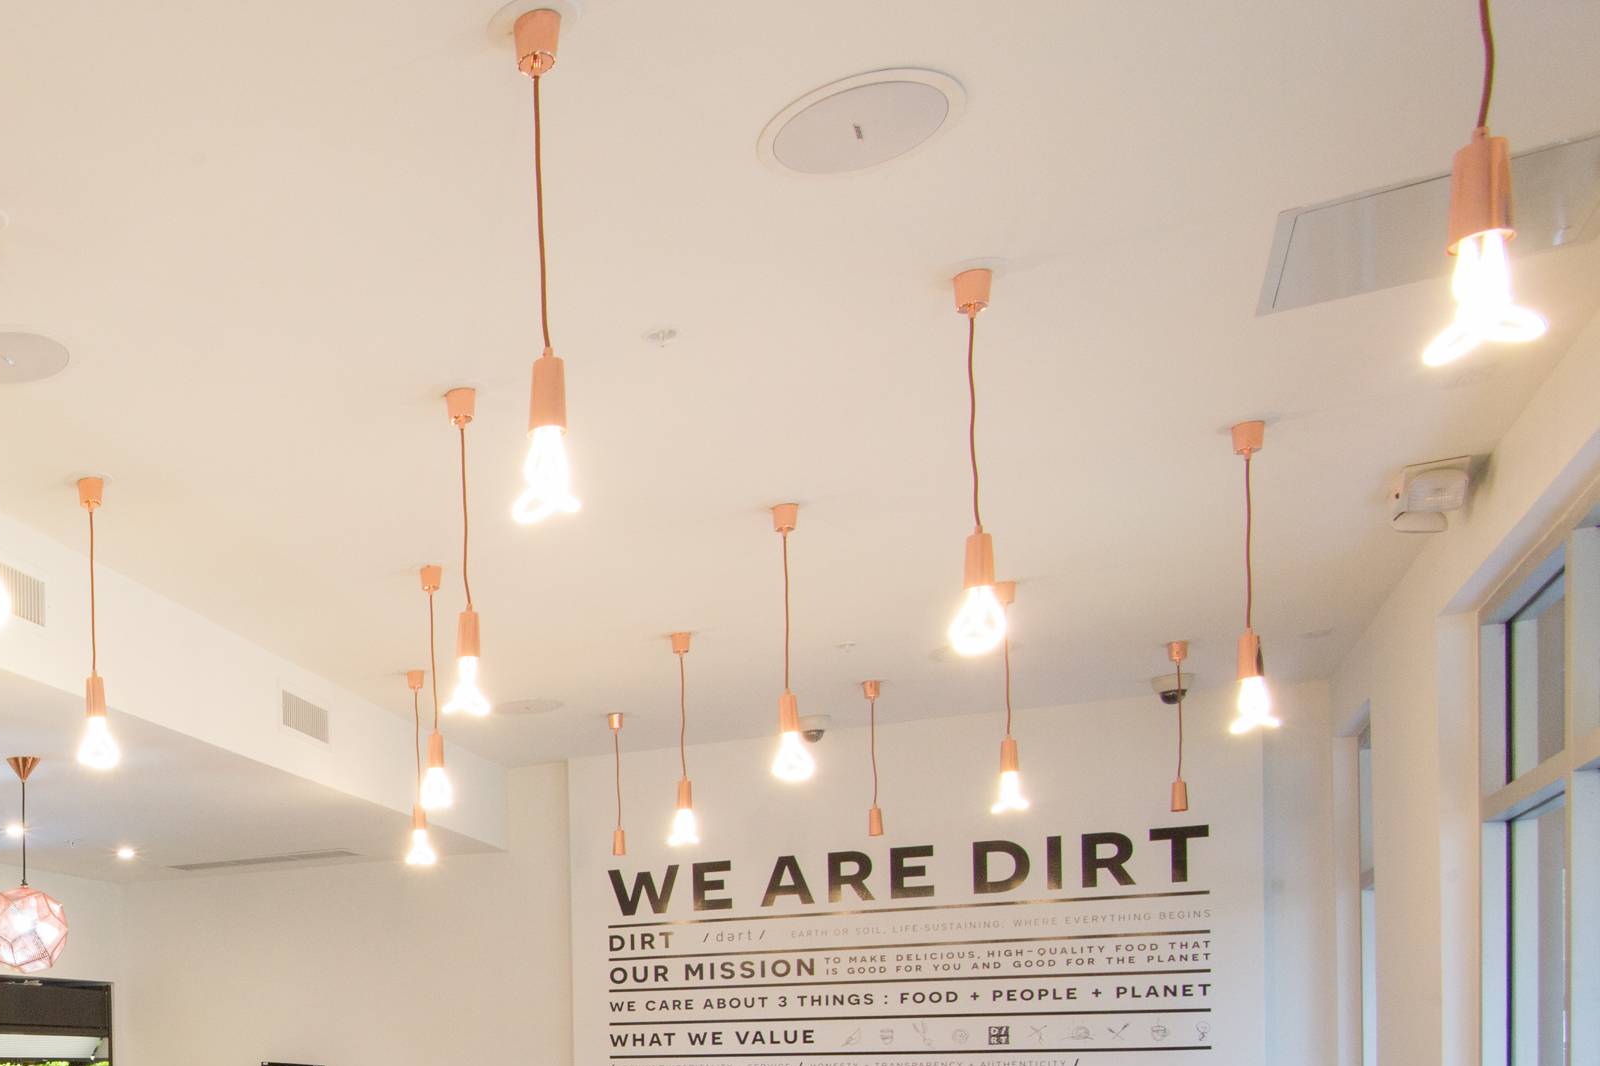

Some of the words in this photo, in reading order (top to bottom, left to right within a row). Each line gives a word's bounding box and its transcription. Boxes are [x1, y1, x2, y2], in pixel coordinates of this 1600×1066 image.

[608, 860, 733, 916] WE
[761, 844, 936, 908] ARE
[973, 824, 1210, 894] DIRT
[609, 932, 673, 952] DIRT
[791, 928, 828, 938] EARTH
[833, 928, 849, 936] OR
[1013, 917, 1057, 927] WHERE
[1064, 912, 1152, 925] EVERYTHING
[1159, 909, 1211, 920] BEGINS
[824, 956, 841, 965] TO
[849, 954, 888, 964] MAKE
[987, 945, 1105, 958] HIGH-QUALITY
[1115, 943, 1159, 952] FOOD
[1169, 940, 1211, 950] THAT
[826, 967, 838, 976] IS
[847, 966, 887, 975] GOOD
[895, 965, 923, 973] FOR
[933, 963, 961, 972] YOU
[971, 961, 1001, 970] AND
[1013, 959, 1057, 968] GOOD
[1066, 958, 1096, 967] FOR
[1106, 956, 1136, 965] THE
[1147, 953, 1211, 963] PLANET
[610, 965, 669, 984] OUR
[684, 958, 815, 981] MISSION
[610, 1001, 636, 1012] WE
[645, 999, 694, 1011] CARE
[703, 997, 768, 1010] ABOUT
[778, 996, 788, 1007] 3
[797, 993, 874, 1007] THINGS
[900, 991, 959, 1004] FOOD
[992, 987, 1078, 1002] PEOPLE
[1116, 984, 1211, 999] PLANET
[610, 1033, 676, 1047] WHAT
[688, 1032, 723, 1046] WE
[736, 1030, 815, 1045] VALUE
